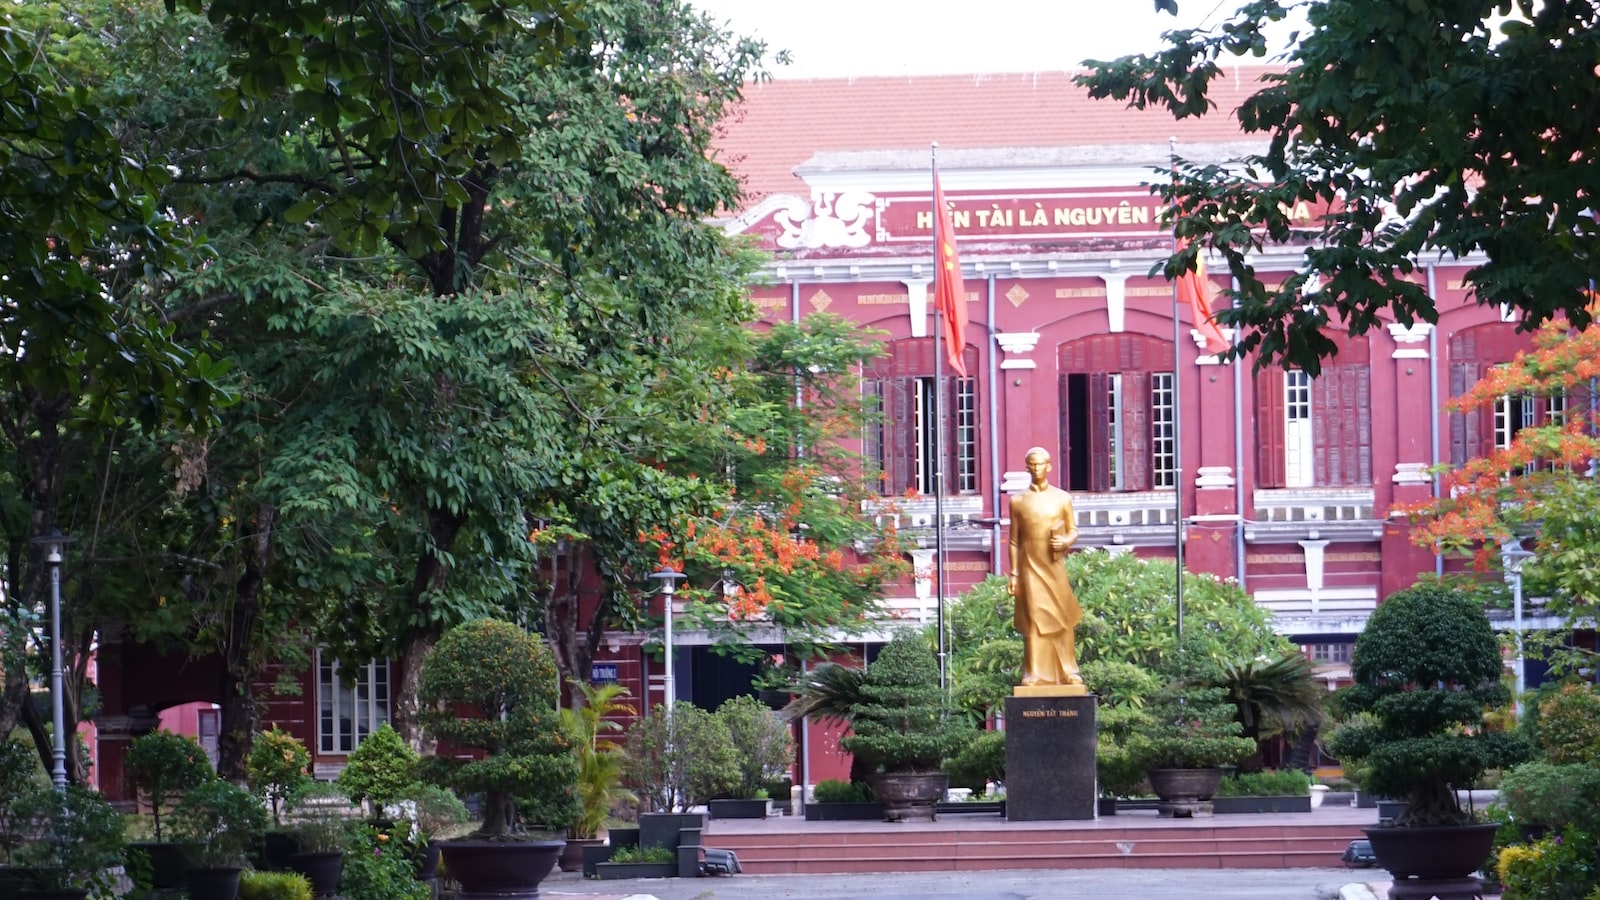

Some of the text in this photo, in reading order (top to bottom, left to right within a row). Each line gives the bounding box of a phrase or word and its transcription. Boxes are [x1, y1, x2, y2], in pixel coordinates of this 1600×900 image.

[917, 202, 970, 228] HN
[976, 204, 1013, 227] TÀI
[1019, 202, 1048, 227] LÀ
[1054, 200, 1148, 226] NGUYÊN
